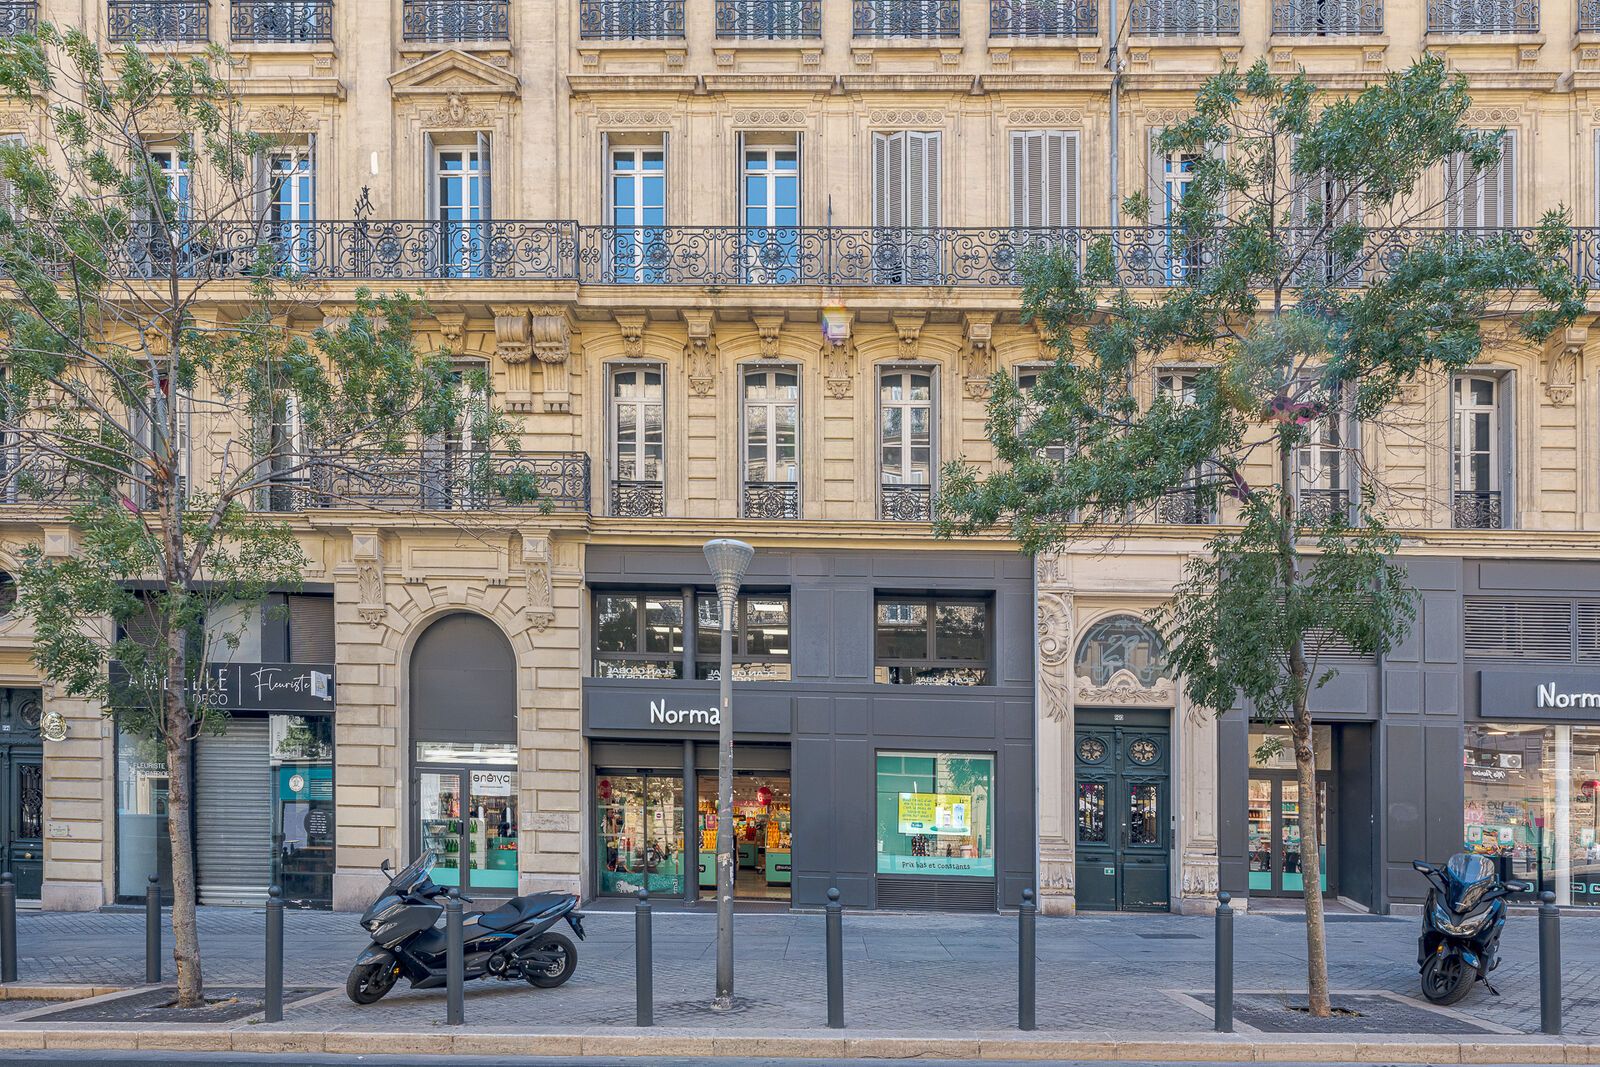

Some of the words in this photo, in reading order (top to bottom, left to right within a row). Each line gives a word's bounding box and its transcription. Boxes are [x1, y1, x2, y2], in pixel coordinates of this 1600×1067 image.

[128, 668, 228, 690] AMLLE
[250, 667, 311, 701] Fleuriste
[650, 698, 722, 725] Norma
[916, 861, 928, 869] bas
